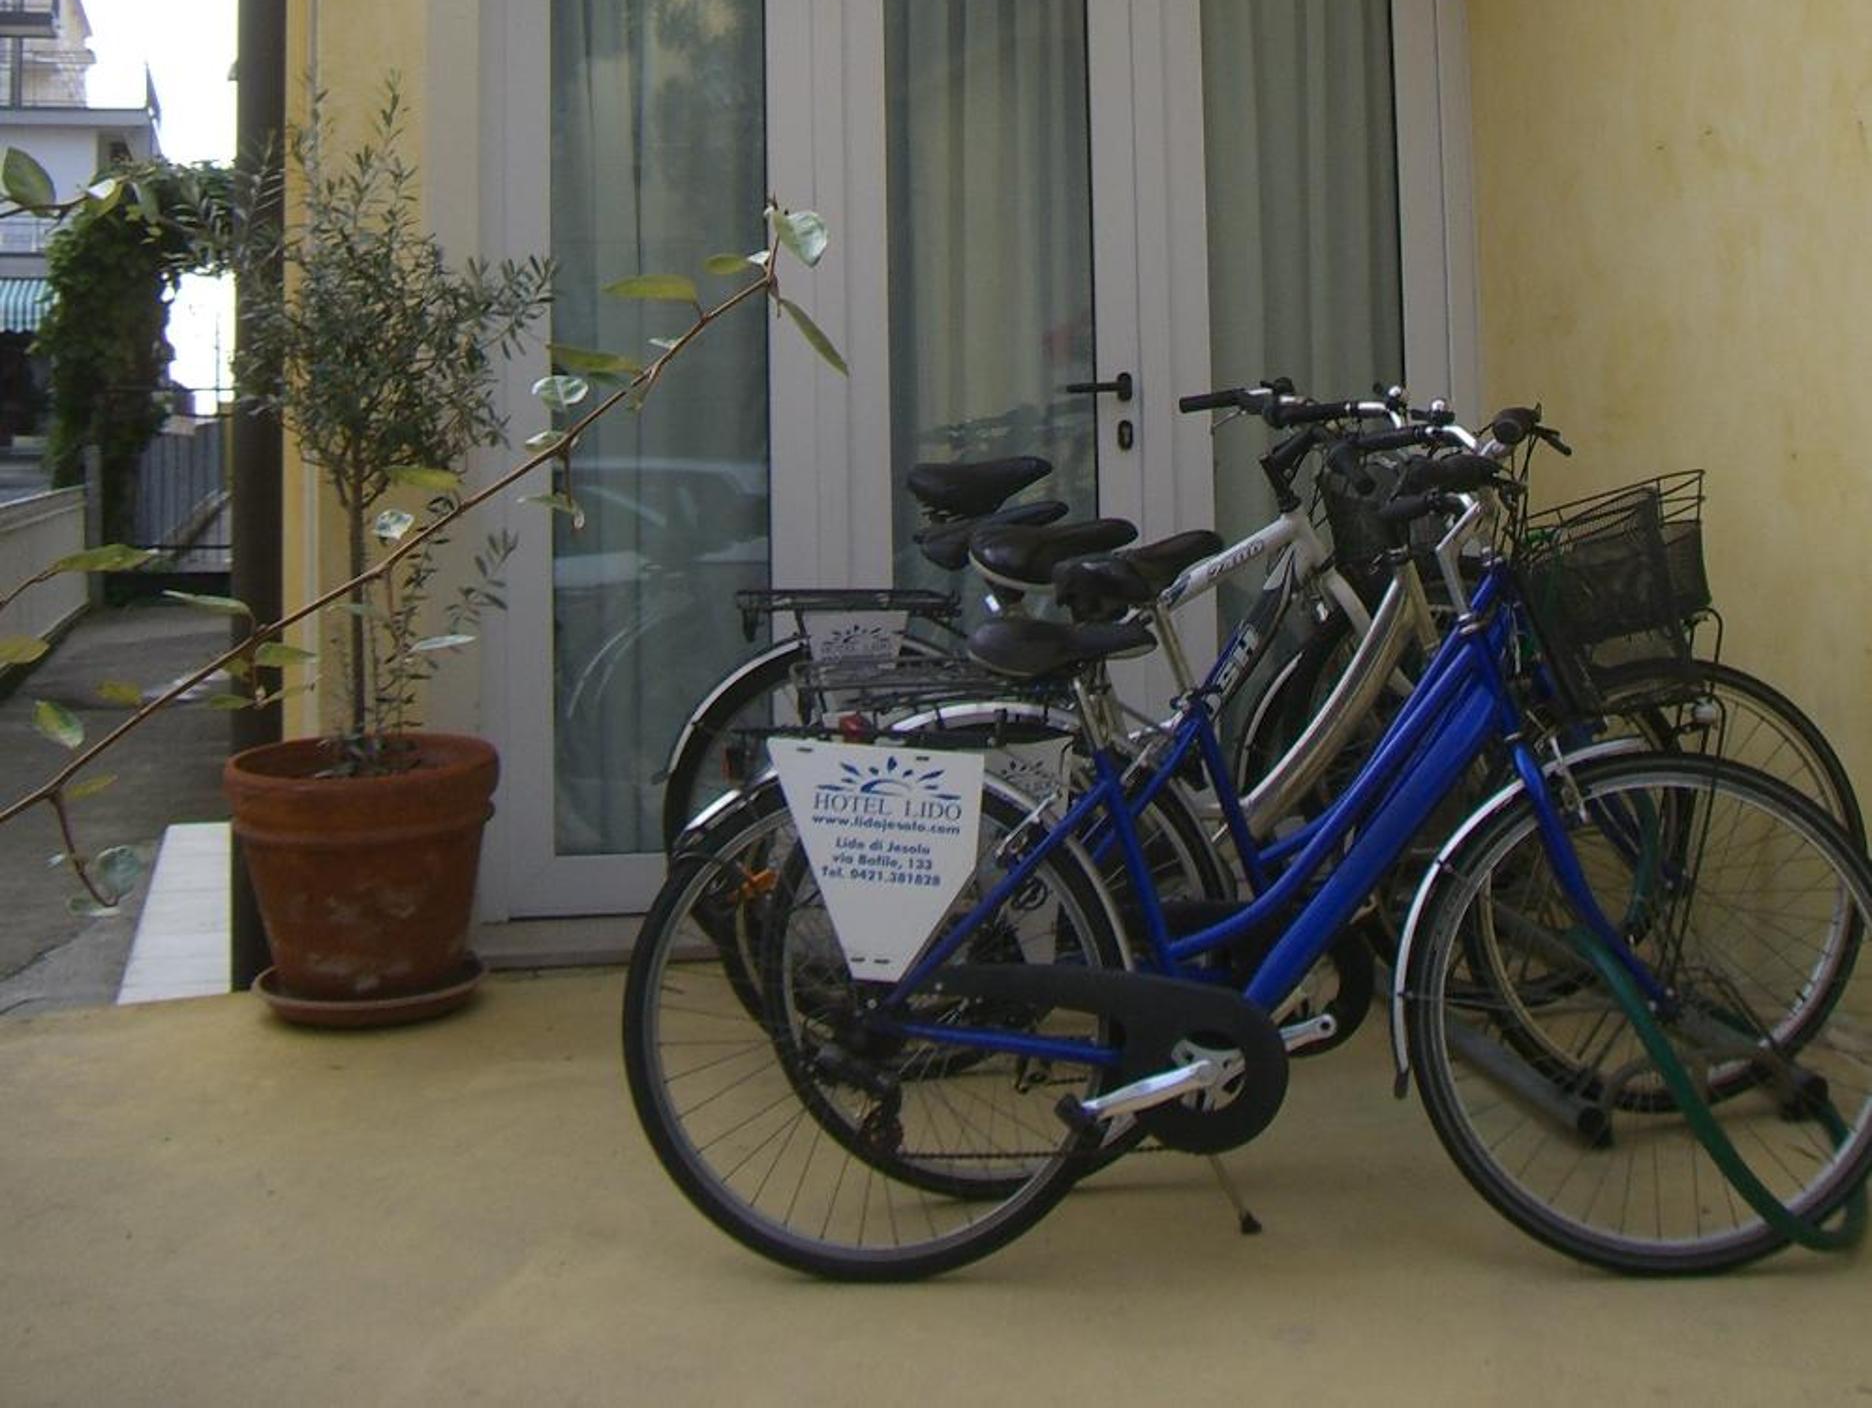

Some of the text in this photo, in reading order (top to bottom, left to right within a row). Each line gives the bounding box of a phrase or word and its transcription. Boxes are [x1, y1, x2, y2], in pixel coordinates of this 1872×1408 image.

[814, 792, 962, 820] HOTEL LIDO
[812, 814, 960, 835] www.lidojesolo.com
[836, 836, 930, 855] Lido di Jesolo
[833, 852, 853, 864] via
[822, 865, 844, 877] Tel.
